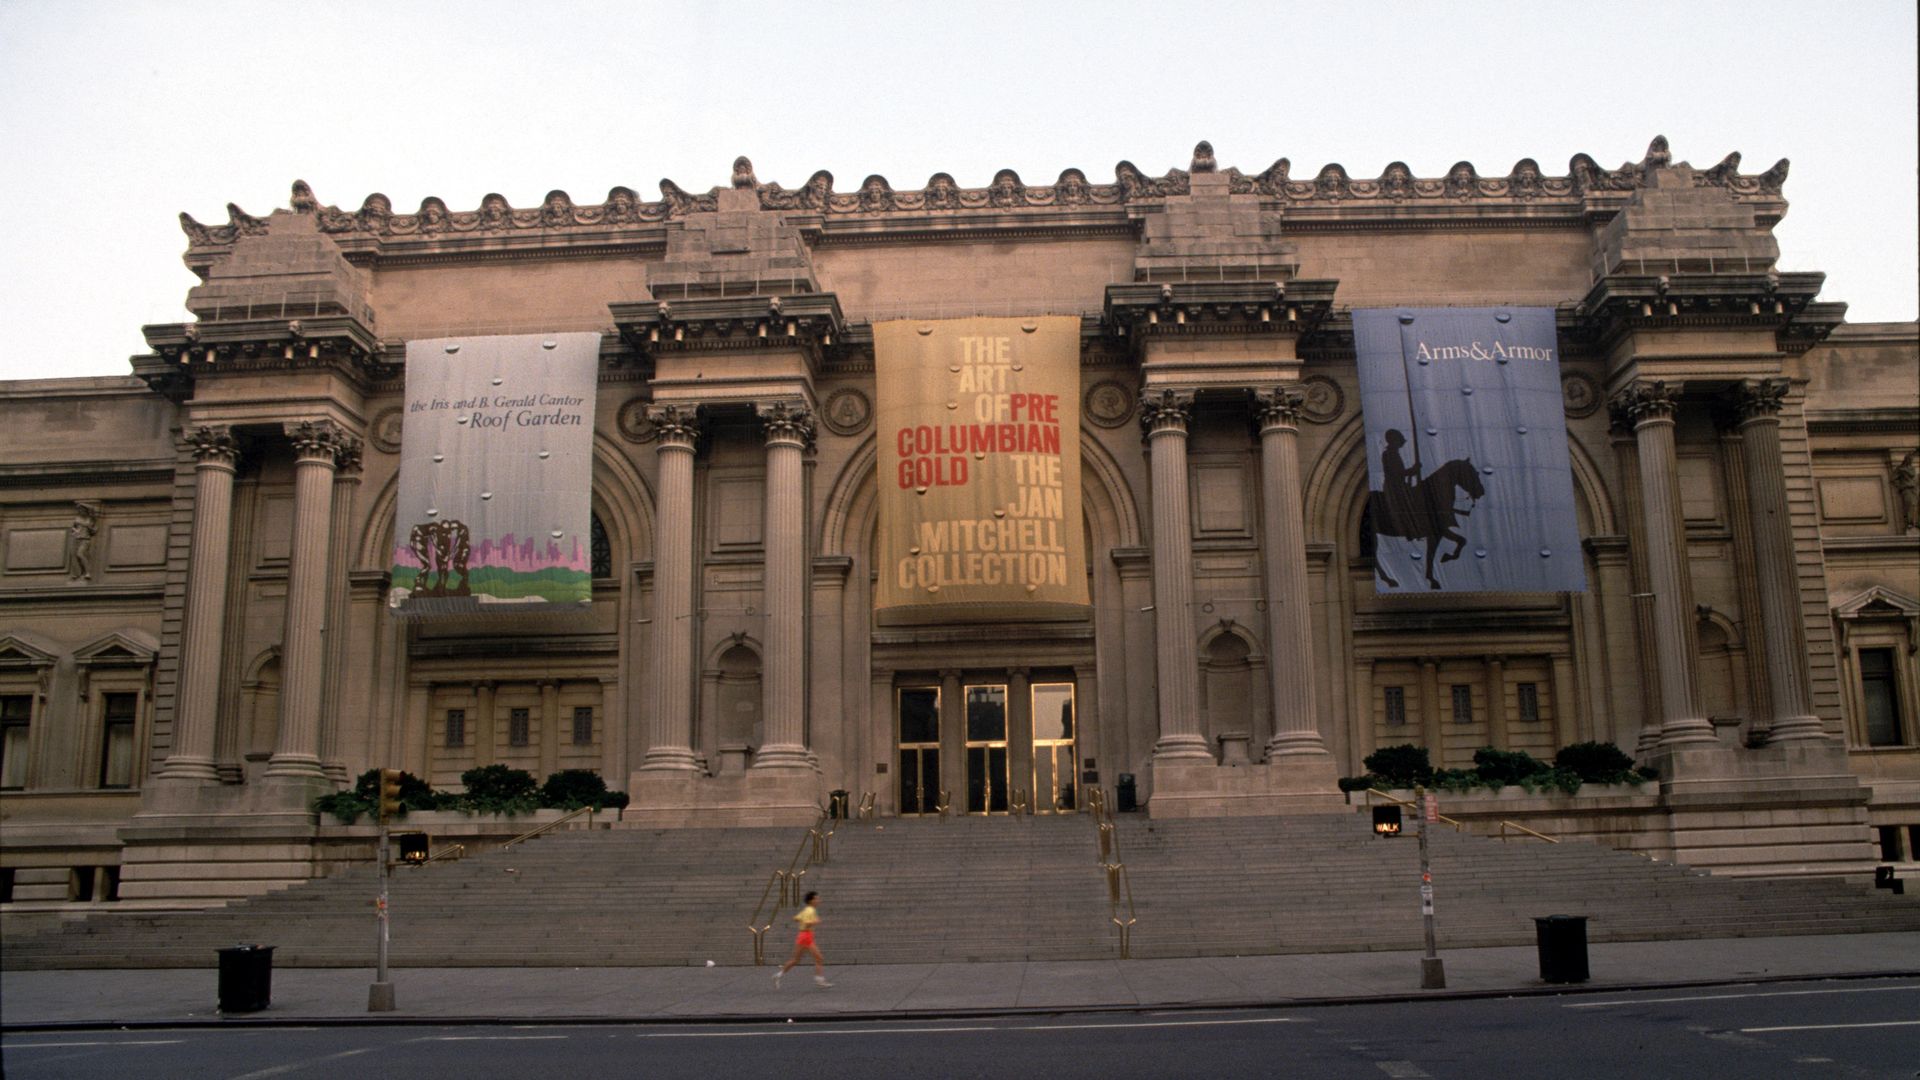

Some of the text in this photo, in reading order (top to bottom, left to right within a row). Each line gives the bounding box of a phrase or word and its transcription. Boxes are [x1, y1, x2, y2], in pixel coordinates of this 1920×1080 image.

[960, 336, 1010, 364] THE
[1416, 341, 1552, 361] Arms&Armor
[960, 365, 1010, 393] ART
[410, 393, 584, 413] the Iris and B. Gerald Cantor
[975, 393, 1059, 424] OF PRE
[470, 408, 582, 432] Roof Garden
[897, 424, 1061, 458] COLUMBIAN
[898, 456, 968, 490] GOLD
[1010, 454, 1062, 487] THE
[1008, 486, 1063, 520] JAN
[920, 519, 1064, 553] MITCHELL
[899, 554, 1067, 589] COLLECTION
[1376, 823, 1399, 832] WALK
